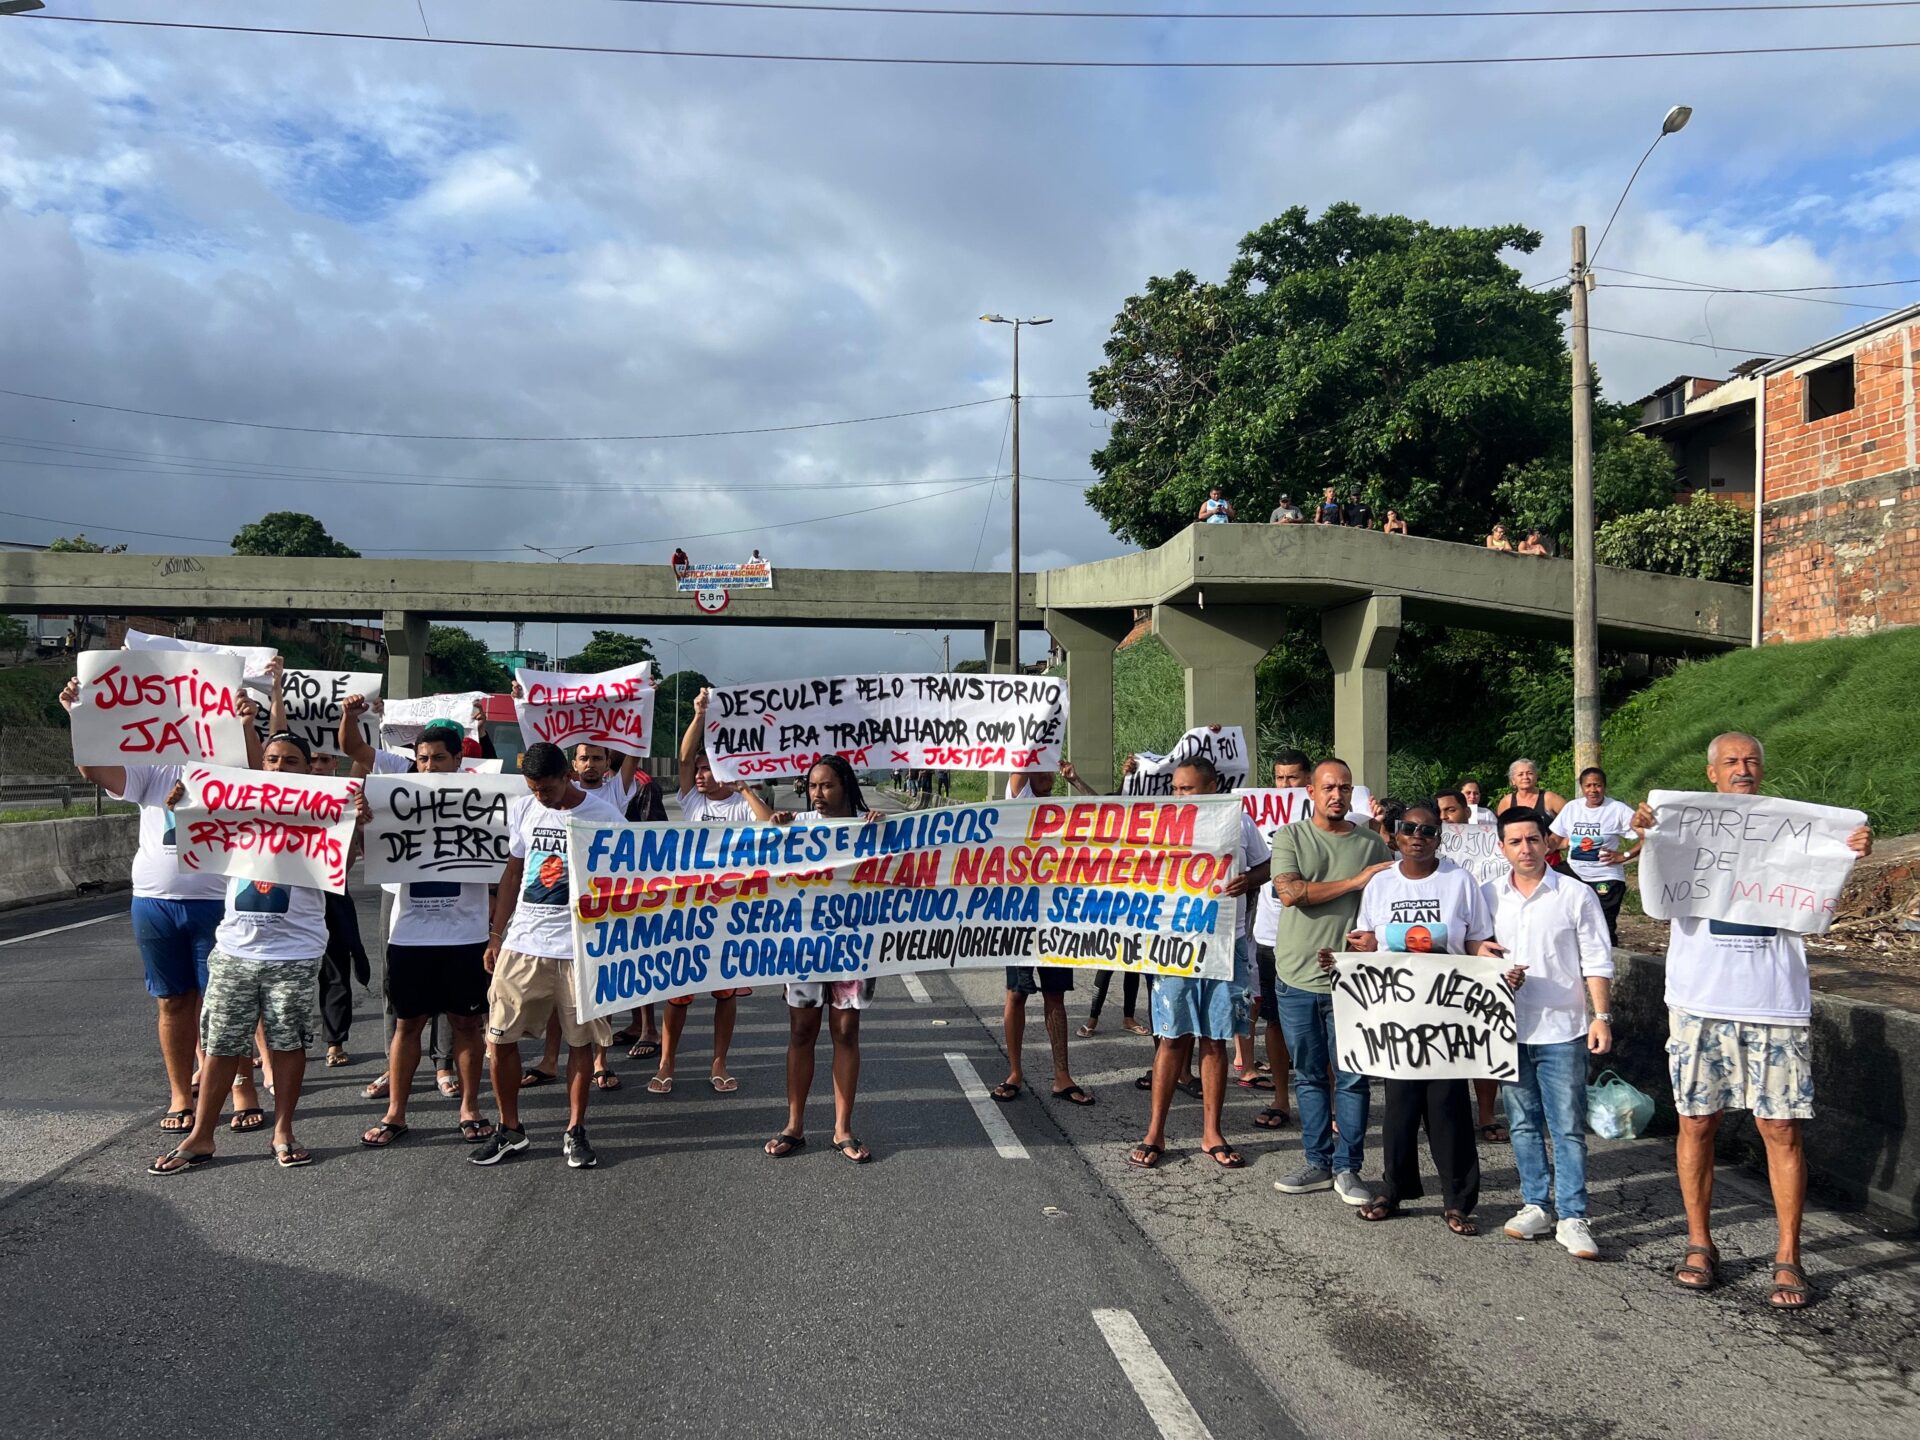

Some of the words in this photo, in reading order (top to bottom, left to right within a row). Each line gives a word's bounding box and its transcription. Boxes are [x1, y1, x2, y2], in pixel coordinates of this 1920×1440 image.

[700, 593, 715, 601] 5.8
[331, 674, 351, 702] É
[528, 682, 606, 708] CHEGA
[612, 678, 643, 703] DE
[717, 679, 848, 718] DESCULPE
[855, 677, 903, 702] PELO
[779, 722, 820, 752] ERA
[824, 716, 970, 747] TRABALHADOR
[977, 719, 1015, 743] COMO
[1011, 746, 1047, 768] JÁ
[202, 780, 349, 824] QUEREMOS
[390, 787, 508, 826] CHEGA
[187, 819, 345, 869] RESPOSTAS
[380, 828, 426, 863] DE
[587, 826, 831, 873] FAMILIARES
[835, 826, 849, 851] E
[854, 808, 998, 857] AMIGOS
[1027, 803, 1199, 848] PEDEM
[1572, 827, 1601, 836] ALAN
[1678, 806, 1812, 854] PAREM
[1693, 847, 1739, 871] DE
[578, 869, 770, 923] JUSTIÇA
[850, 849, 942, 890] ALAN
[951, 845, 1234, 898] NASCIMENTO!
[1660, 879, 1710, 904] NOS
[1731, 881, 1839, 914] MATAR
[586, 904, 718, 958] JAMAIS
[727, 889, 804, 936] SERÁ
[965, 886, 1040, 923] PARA
[1046, 887, 1167, 931] SEMPRE
[1171, 895, 1219, 934] EM
[1390, 910, 1441, 923] ALAN
[1393, 901, 1421, 909] JUSTIÇA
[1422, 900, 1438, 908] POR
[595, 944, 711, 1005] NOSSOS
[720, 928, 874, 982] CORAÇÕES!
[1038, 926, 1121, 960] ESTAMOS
[1123, 933, 1142, 964] DE
[1150, 935, 1207, 973] LUTO!
